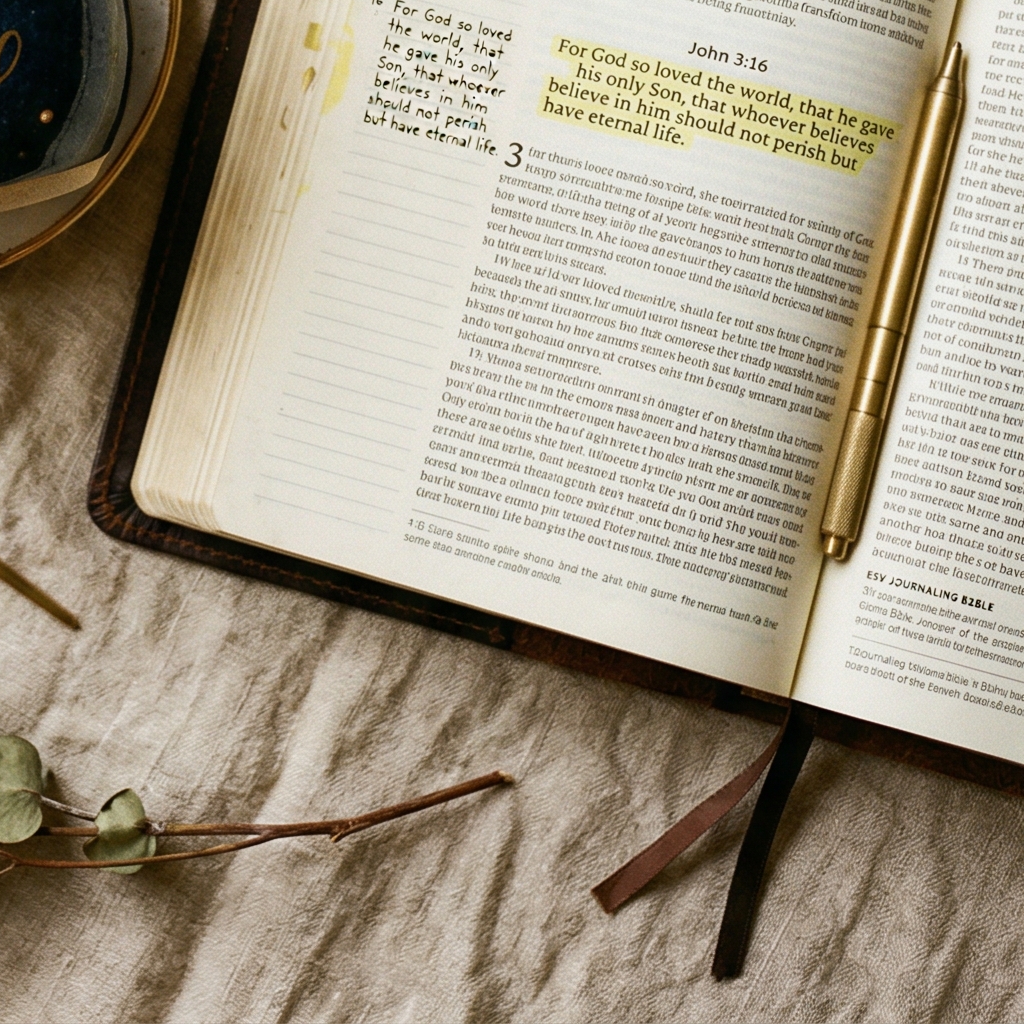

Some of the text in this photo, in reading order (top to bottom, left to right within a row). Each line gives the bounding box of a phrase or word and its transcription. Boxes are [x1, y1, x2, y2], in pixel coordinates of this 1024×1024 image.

[388, 18, 504, 59] the world, that
[394, 0, 418, 16] For
[424, 8, 452, 26] God
[458, 20, 472, 32] so
[478, 21, 512, 42] loved
[378, 56, 406, 78] Son,
[414, 64, 444, 84] that
[383, 36, 499, 81] he gave his only
[688, 42, 768, 72] John 3:16
[374, 73, 488, 114] believes in him
[558, 38, 894, 140] For God so loved the world, that he gave
[576, 63, 874, 154] his only Son, that whoever believes
[364, 110, 498, 156] but have eternal life.
[416, 107, 440, 124] not
[543, 96, 685, 146] have eternal life.
[548, 77, 858, 172] believe in him should not perish but
[504, 142, 524, 168] 3
[866, 570, 887, 582] ESV
[888, 578, 958, 602] JOURNALING
